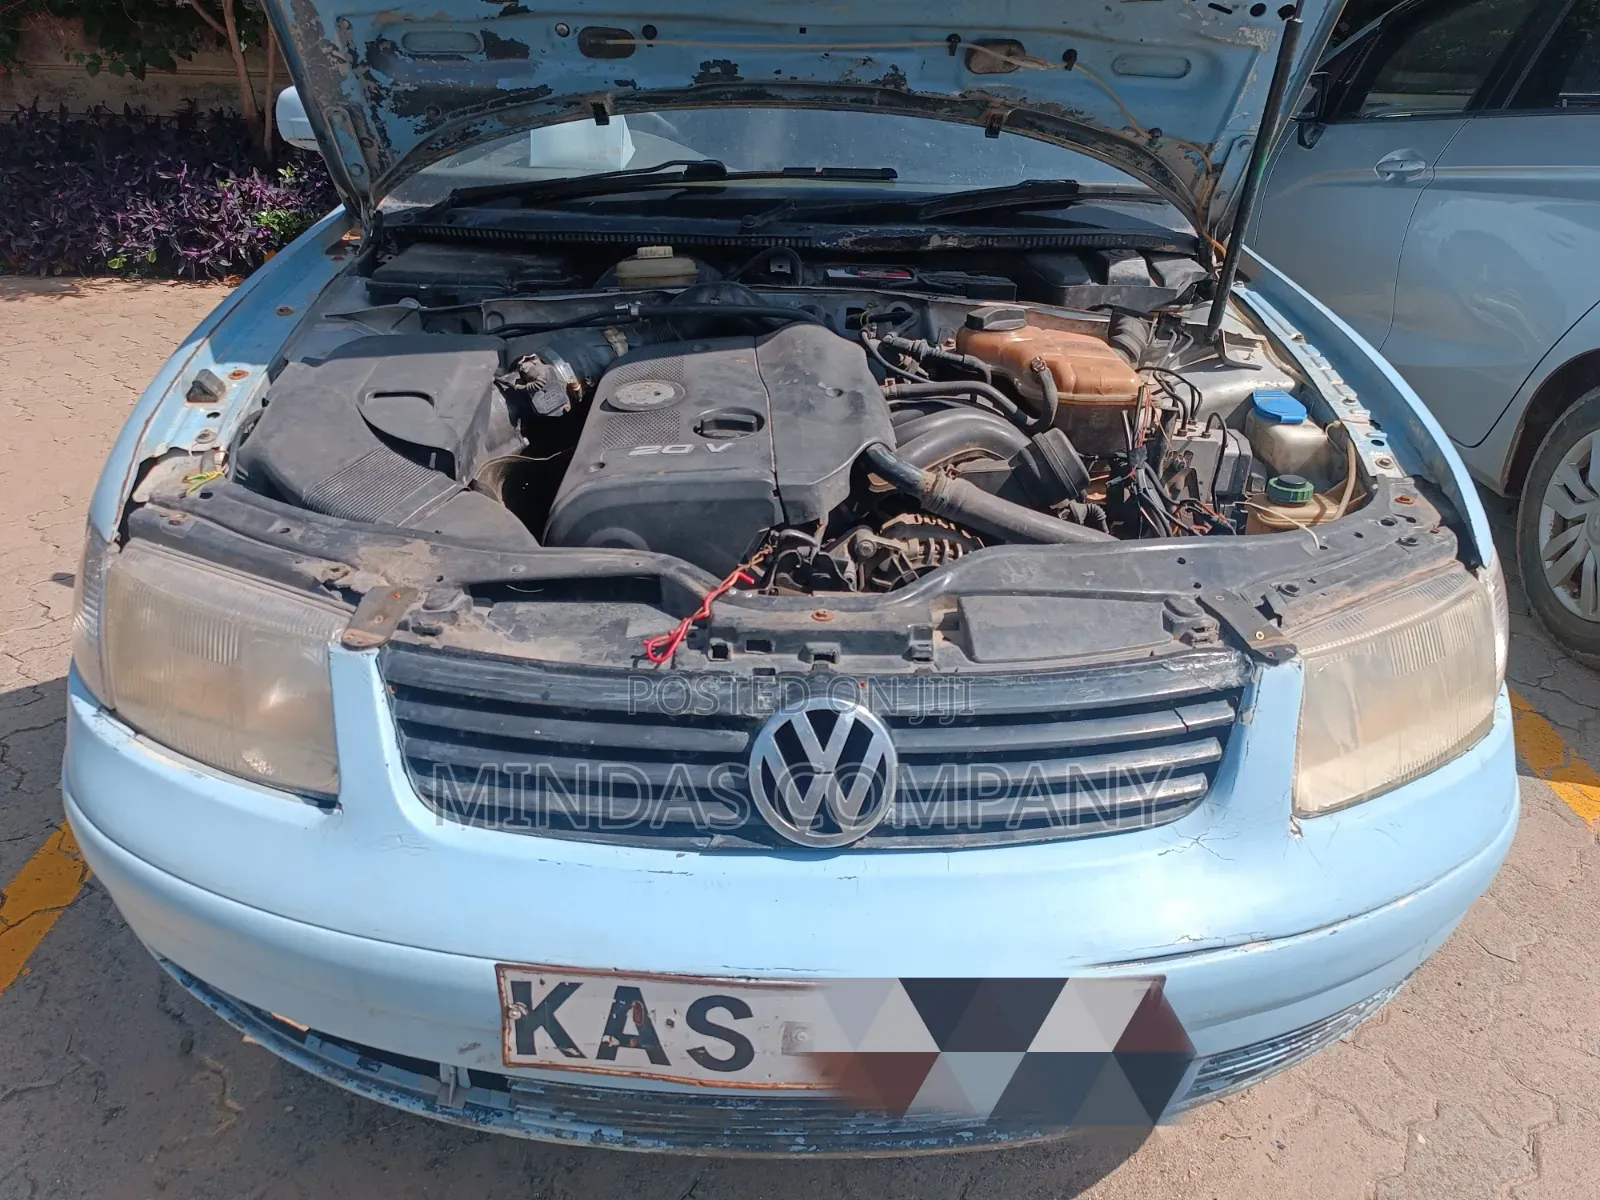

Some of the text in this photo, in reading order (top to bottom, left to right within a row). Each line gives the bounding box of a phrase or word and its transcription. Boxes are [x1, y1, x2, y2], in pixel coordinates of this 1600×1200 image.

[628, 442, 735, 456] 20 V
[510, 980, 755, 1072] KAS
